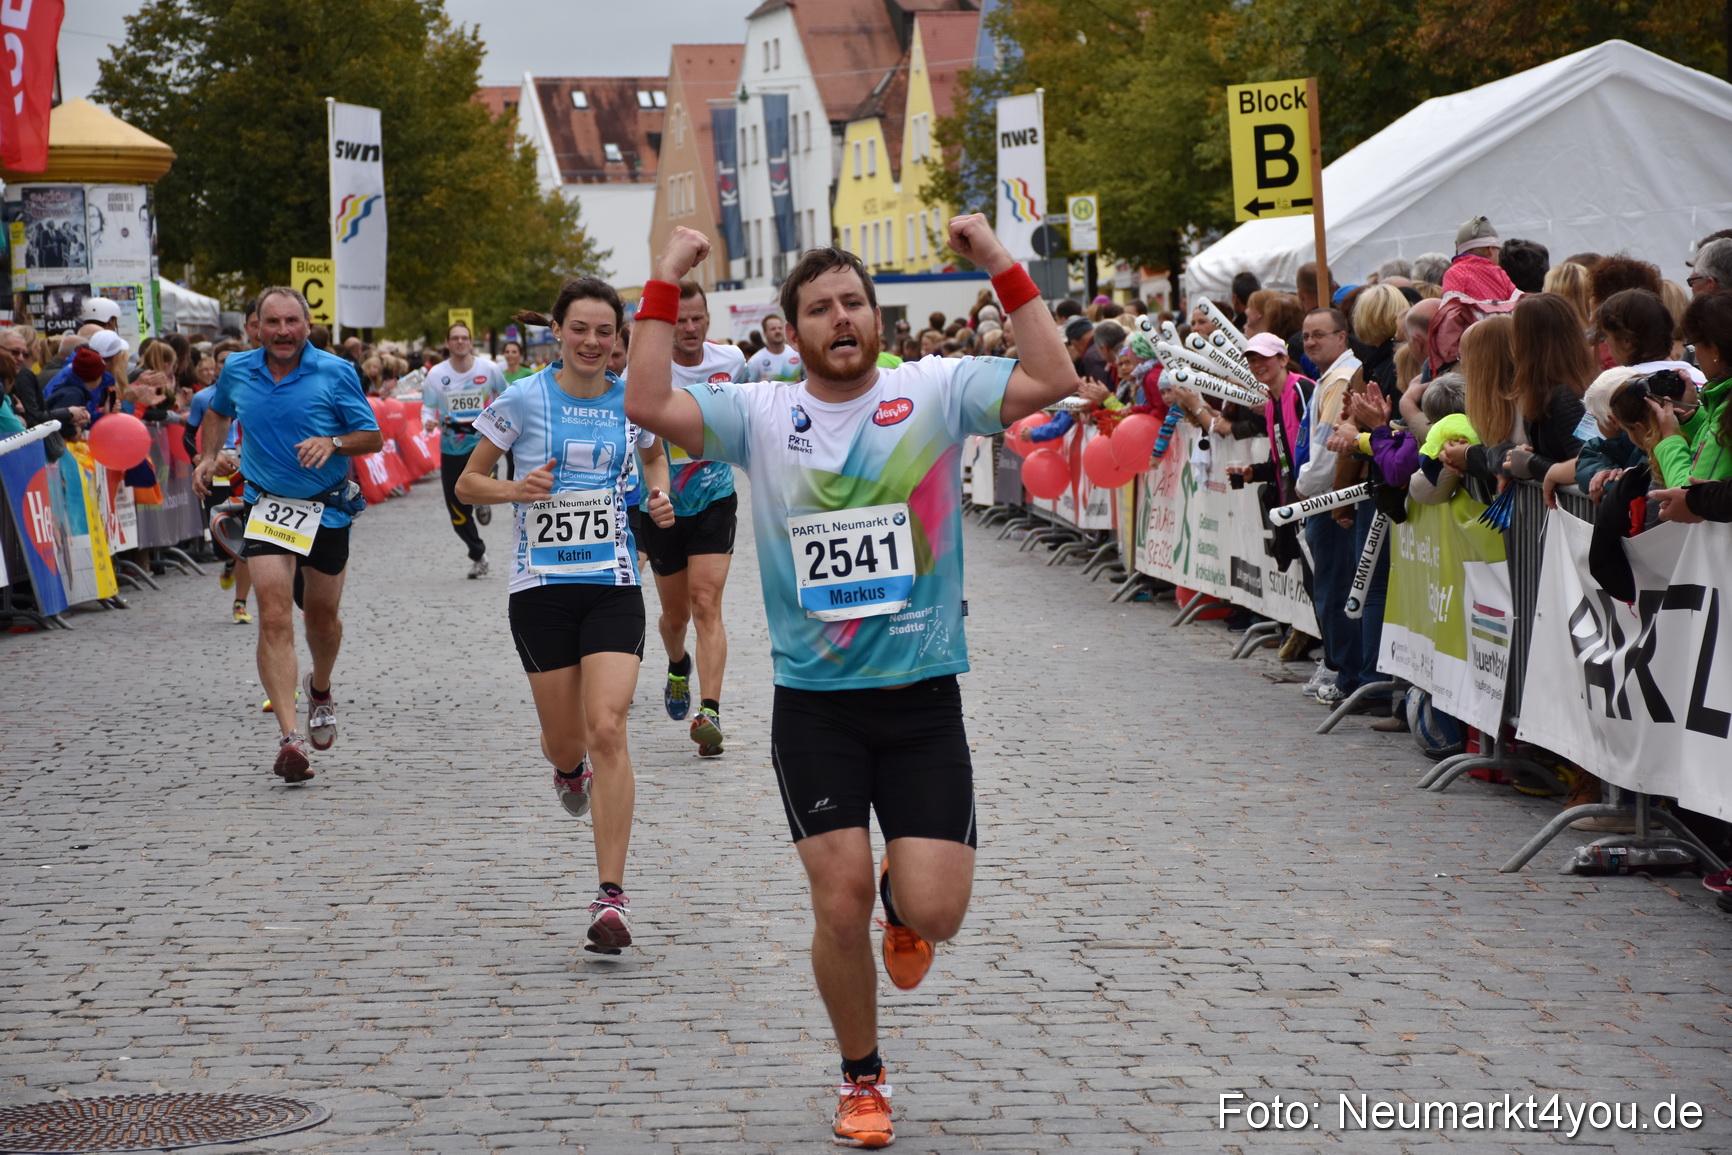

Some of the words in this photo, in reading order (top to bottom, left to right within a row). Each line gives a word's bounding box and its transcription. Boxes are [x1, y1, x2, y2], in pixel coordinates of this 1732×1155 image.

[1239, 86, 1307, 114] Block
[335, 139, 380, 162] swn
[1253, 123, 1299, 189] B
[296, 261, 330, 274] Block
[302, 278, 324, 309] C
[1194, 377, 1223, 393] BMW
[452, 397, 480, 410] 2692
[561, 406, 618, 420] VIERTL
[561, 416, 593, 426] DESIGN
[594, 420, 618, 428] GmbH
[560, 498, 601, 508] Neumarkt
[1300, 493, 1333, 513] BMW
[265, 502, 308, 530] 327
[536, 509, 608, 543] 2575
[264, 526, 296, 543] Thomas
[792, 523, 830, 537] PARTL
[832, 517, 888, 532] Neumarkt
[558, 549, 592, 562] Katrin
[805, 531, 899, 580] 2541
[1353, 556, 1372, 591] BMW
[829, 586, 885, 605] Markus
